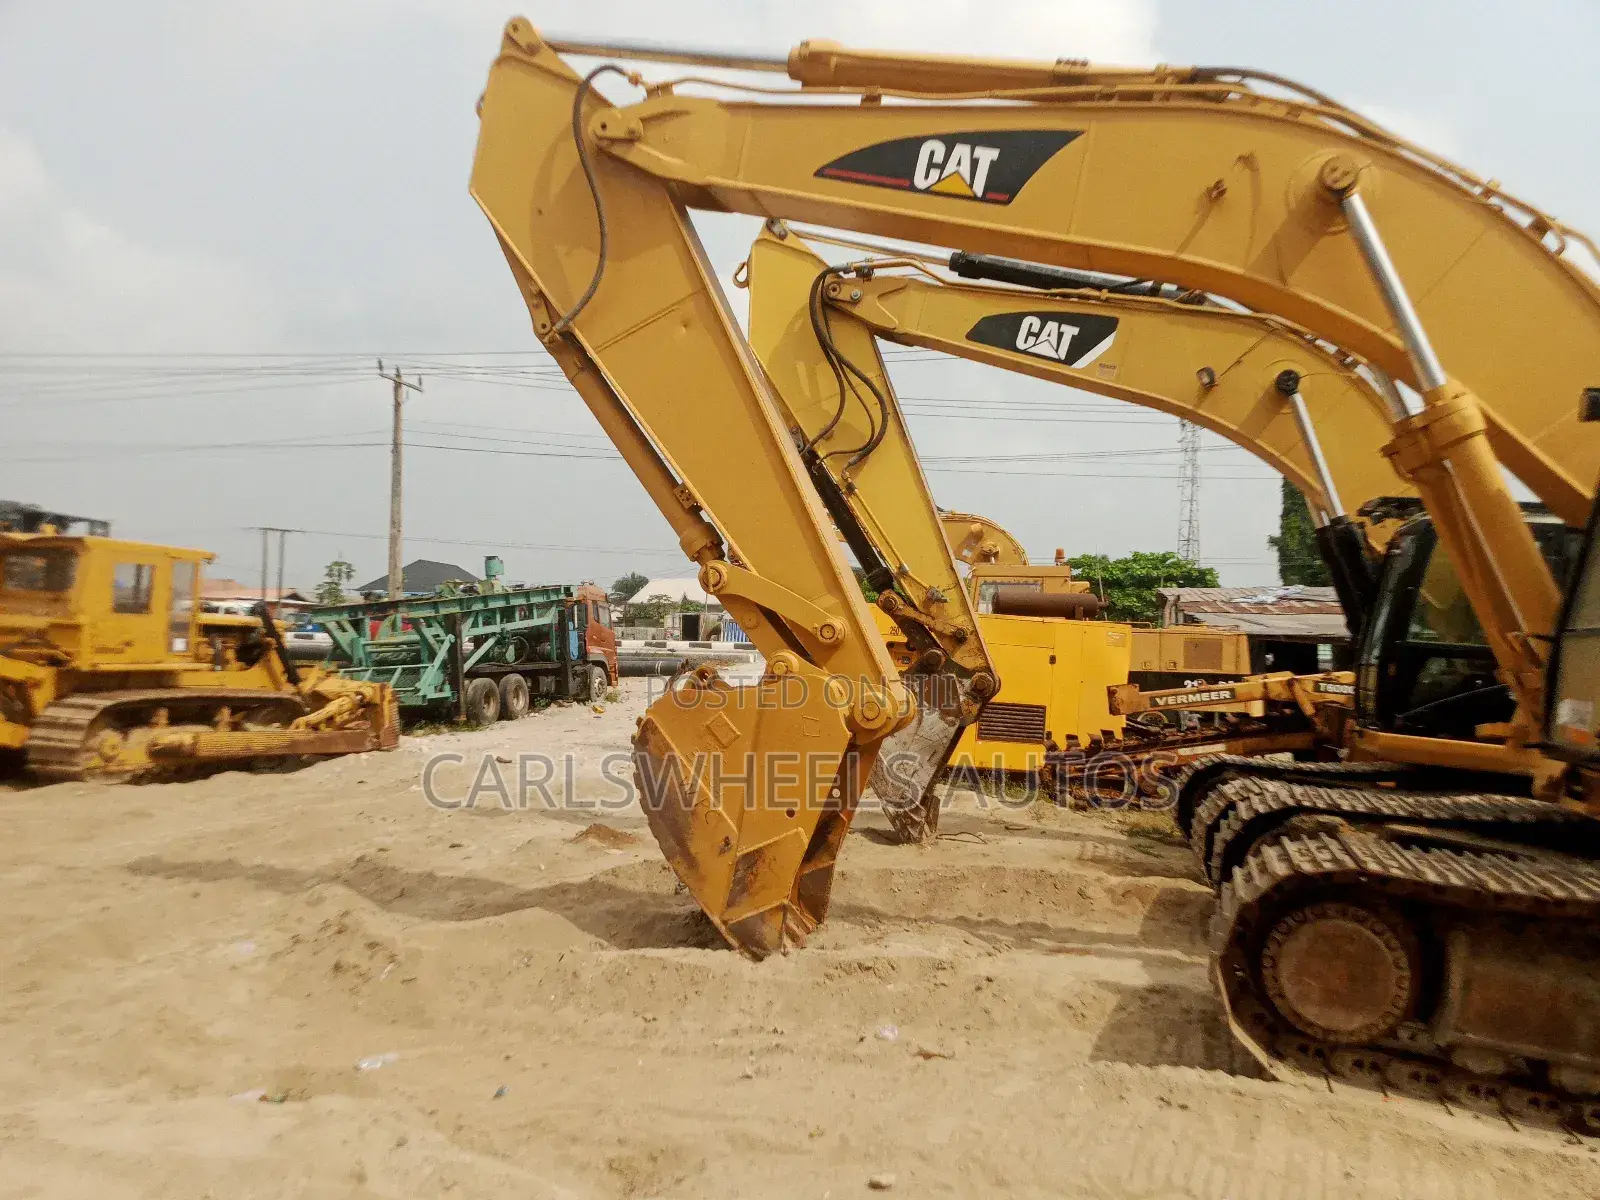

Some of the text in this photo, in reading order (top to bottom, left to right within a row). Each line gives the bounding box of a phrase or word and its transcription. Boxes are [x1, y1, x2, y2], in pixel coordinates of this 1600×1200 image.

[913, 138, 1000, 198] CAT
[1015, 315, 1079, 360] CAT
[1154, 690, 1231, 706] VERMEER
